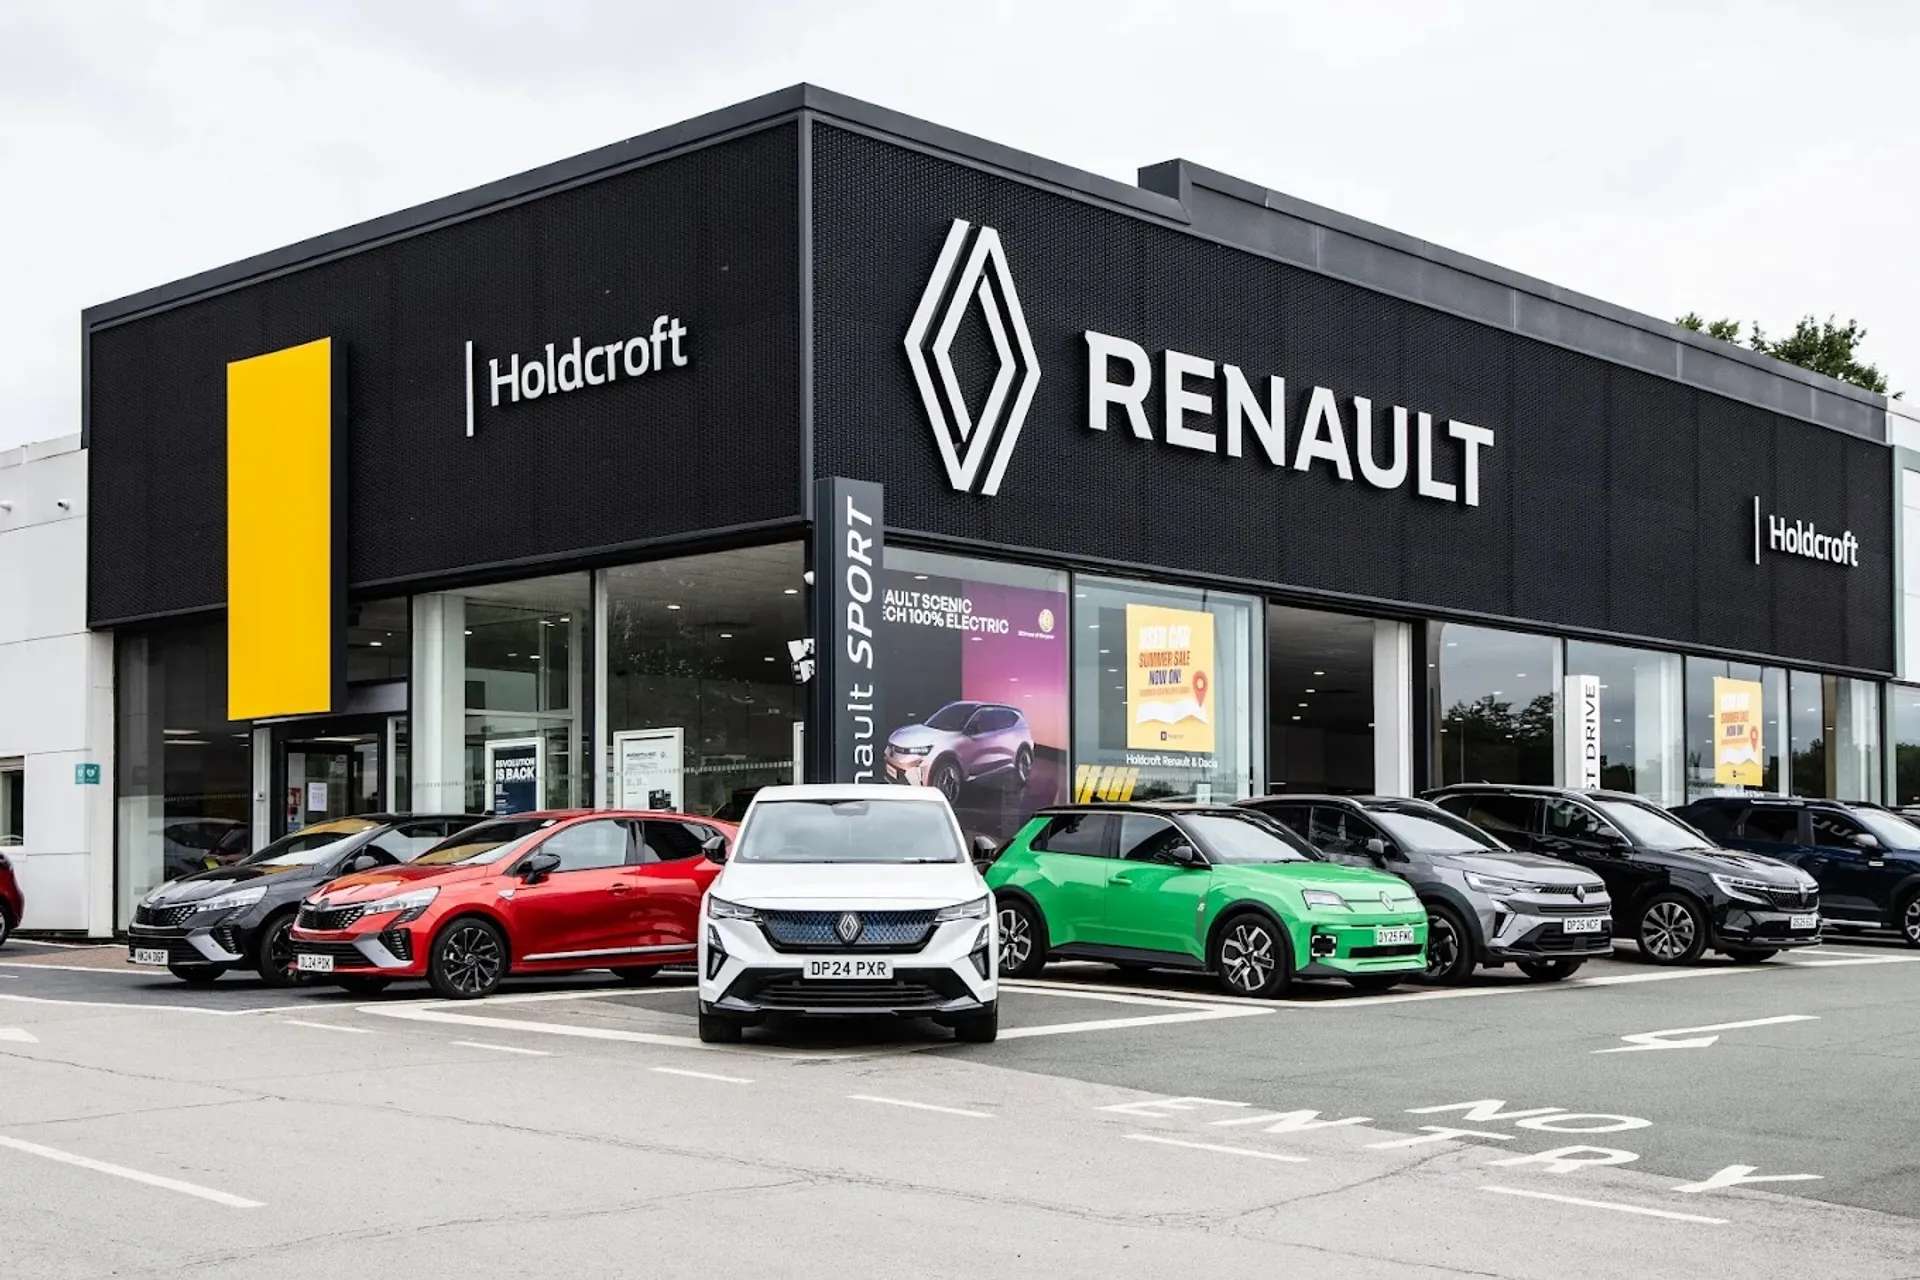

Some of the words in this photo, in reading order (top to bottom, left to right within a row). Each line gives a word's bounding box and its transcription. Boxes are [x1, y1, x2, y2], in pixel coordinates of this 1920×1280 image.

[489, 315, 688, 406] Holdcroft
[1085, 330, 1495, 507] RENAULT
[1769, 515, 1859, 567] Holdcroft
[847, 495, 874, 670] SPORT
[883, 589, 921, 609] AULT
[923, 594, 972, 614] SCENIC
[883, 606, 906, 623] CH
[908, 609, 945, 627] 100%
[946, 613, 1009, 634] ELECTRIC
[1139, 652, 1173, 668] SUMMER
[1174, 651, 1191, 666] SALE
[1149, 670, 1168, 685] NOW
[848, 683, 874, 784] nault
[1585, 684, 1597, 760] DRIVE
[496, 758, 535, 768] REVOLUTION
[496, 768, 505, 781] IS
[506, 767, 535, 781] BACK
[1126, 754, 1162, 766] Holdcroft
[1163, 756, 1190, 767] Renault
[811, 961, 851, 976] DP24
[856, 961, 887, 976] PXR
[1404, 1099, 1653, 1133] NO
[1093, 1097, 1824, 1193] ENTRY
